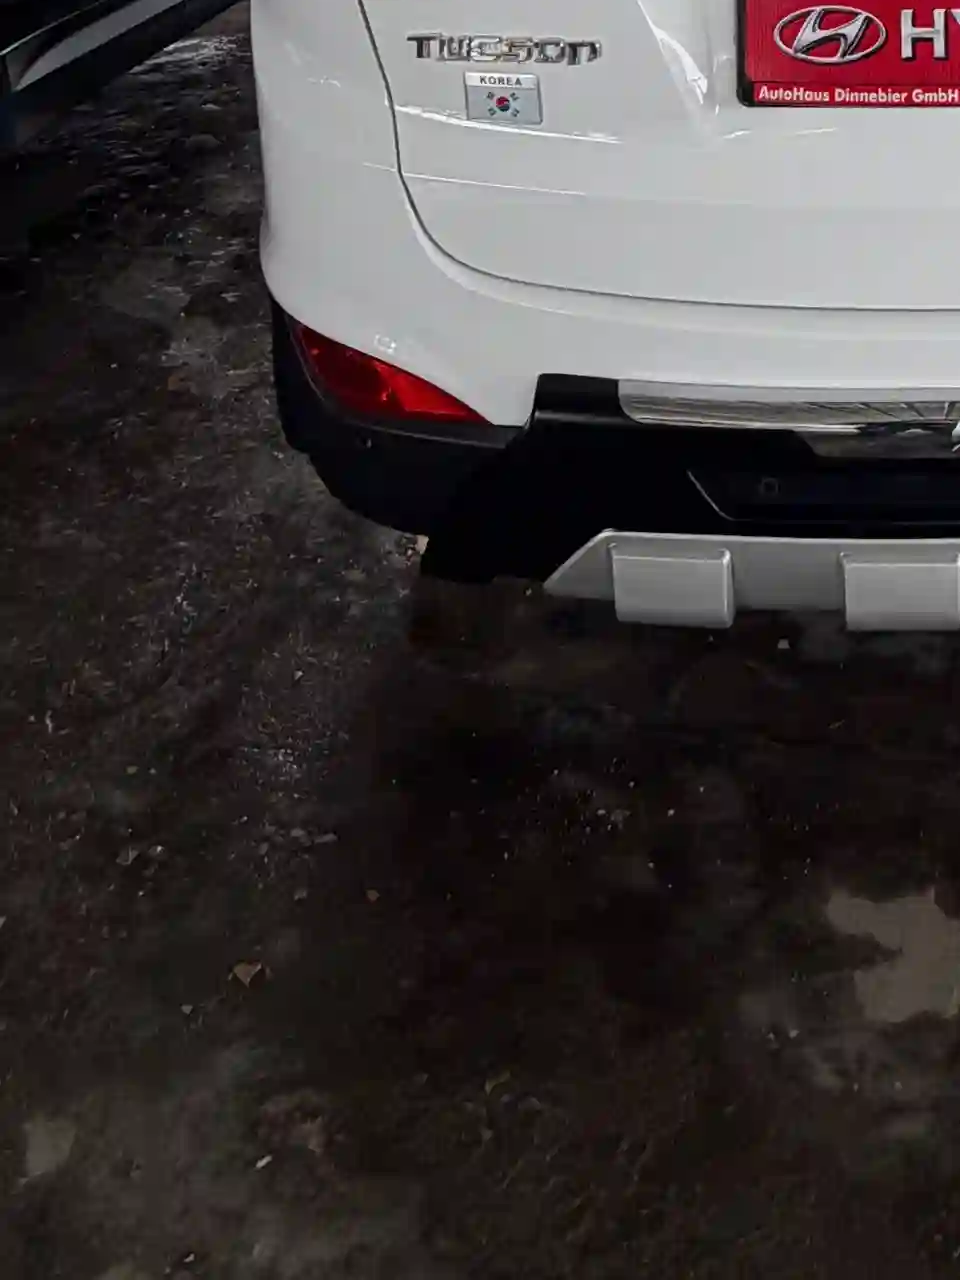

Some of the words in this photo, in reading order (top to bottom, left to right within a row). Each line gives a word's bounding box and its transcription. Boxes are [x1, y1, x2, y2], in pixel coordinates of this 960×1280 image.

[406, 32, 602, 67] TUCSON
[479, 74, 523, 87] KOREA
[759, 85, 830, 102] AutoHaus
[834, 87, 908, 103] Dinnebier
[911, 87, 960, 103] GmbH
